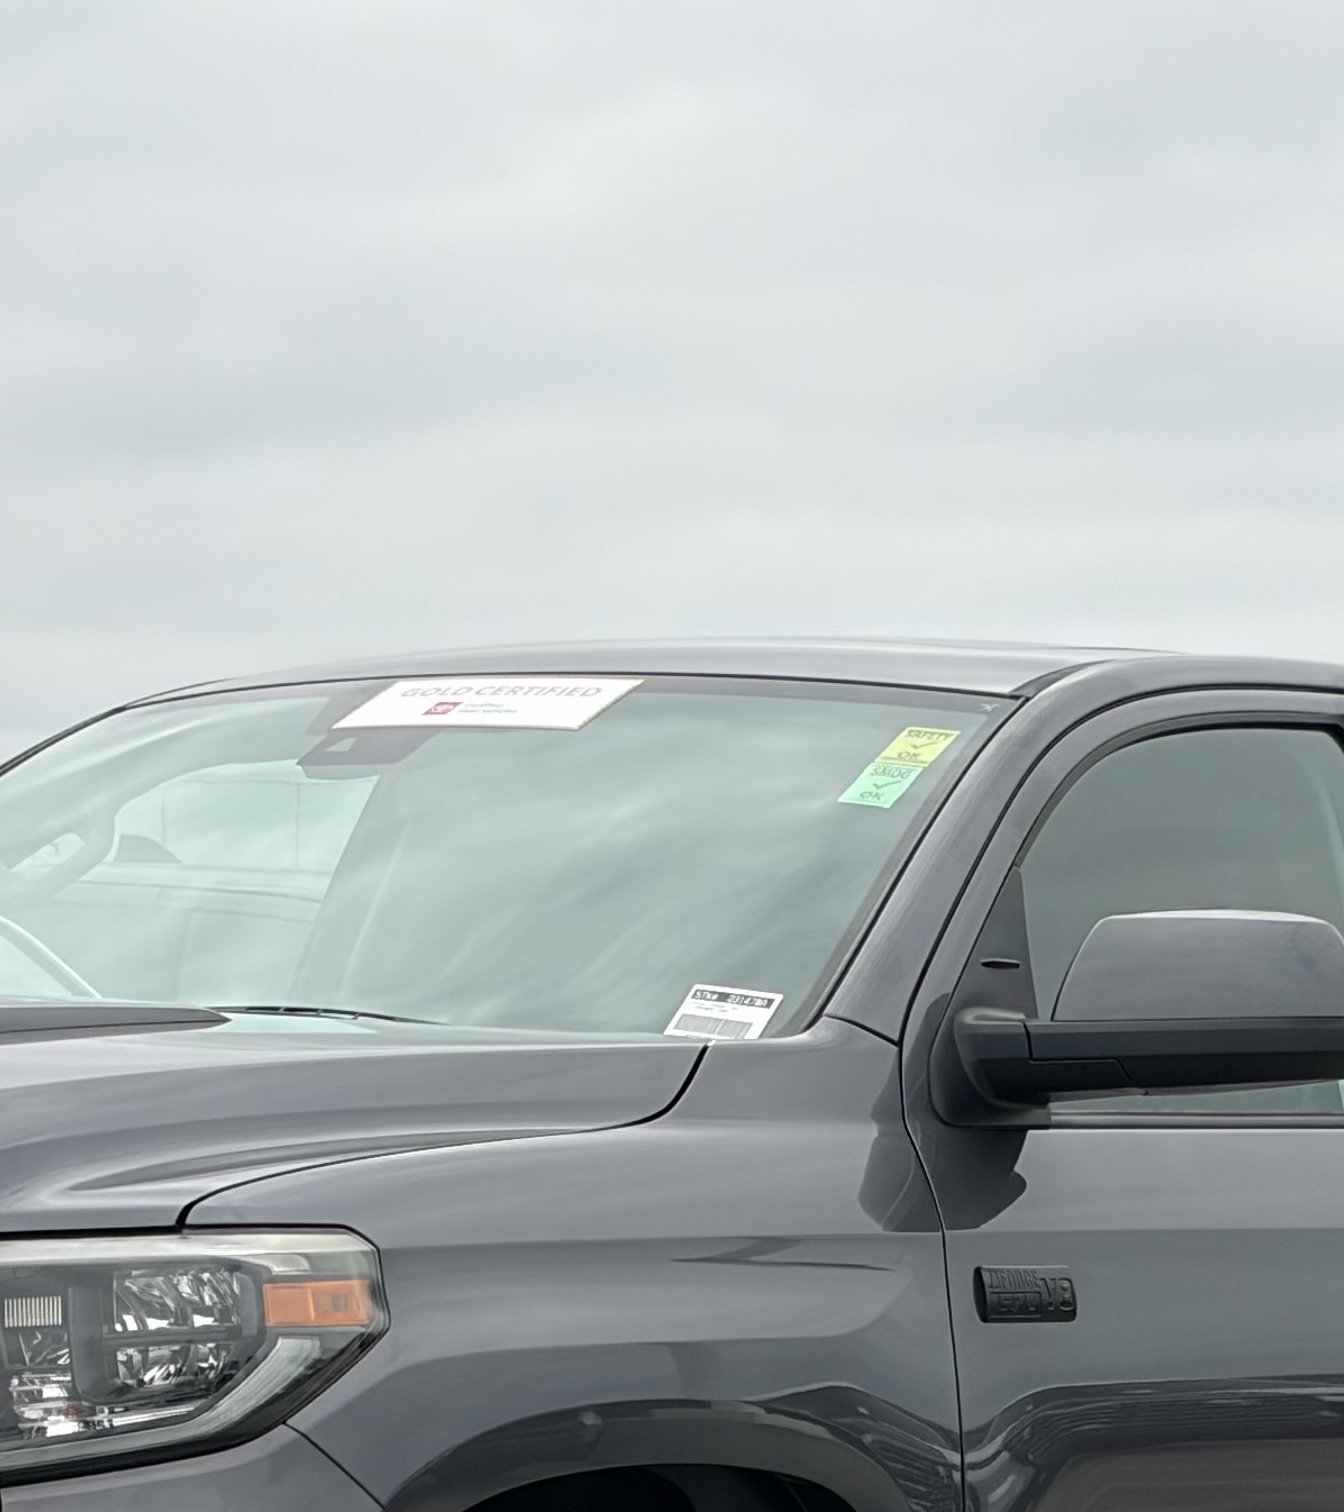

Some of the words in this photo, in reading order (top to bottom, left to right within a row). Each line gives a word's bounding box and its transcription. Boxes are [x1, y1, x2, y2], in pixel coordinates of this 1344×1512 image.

[399, 686, 471, 698] GOLD
[474, 685, 604, 698] CERTIFIED
[897, 751, 921, 760] OK
[869, 765, 913, 779] SMOG
[859, 791, 886, 801] OK
